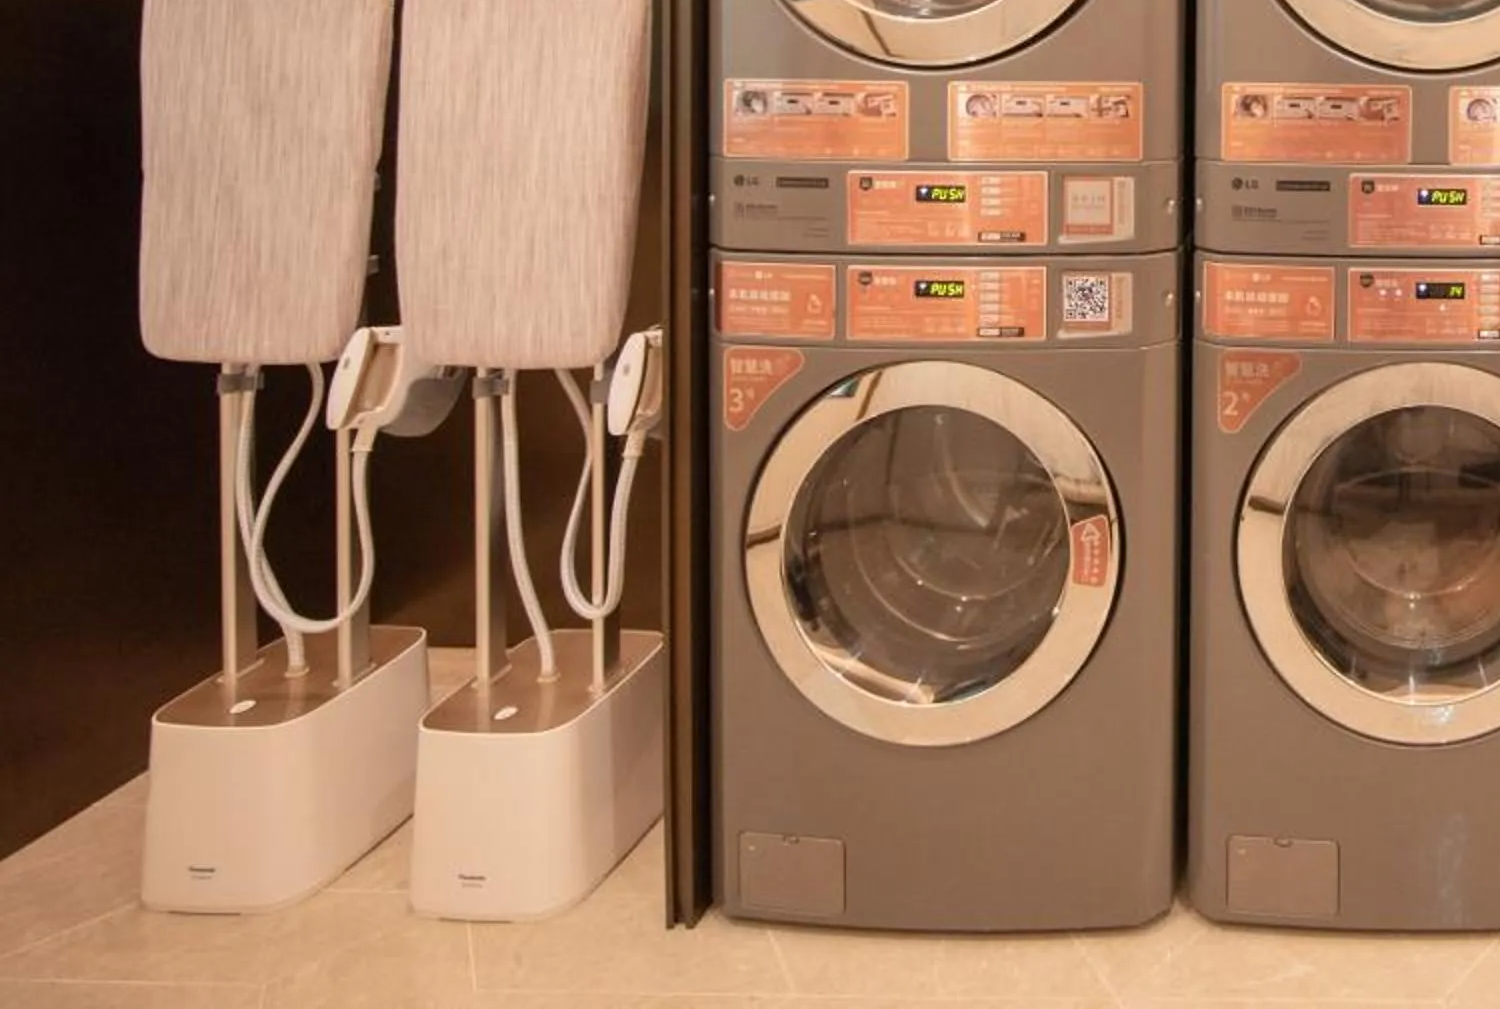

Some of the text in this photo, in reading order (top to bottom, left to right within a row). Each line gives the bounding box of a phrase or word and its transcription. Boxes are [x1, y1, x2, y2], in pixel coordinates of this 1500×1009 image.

[931, 188, 964, 201] PUSH
[1431, 190, 1465, 204] PUSH
[930, 283, 964, 296] PUSH
